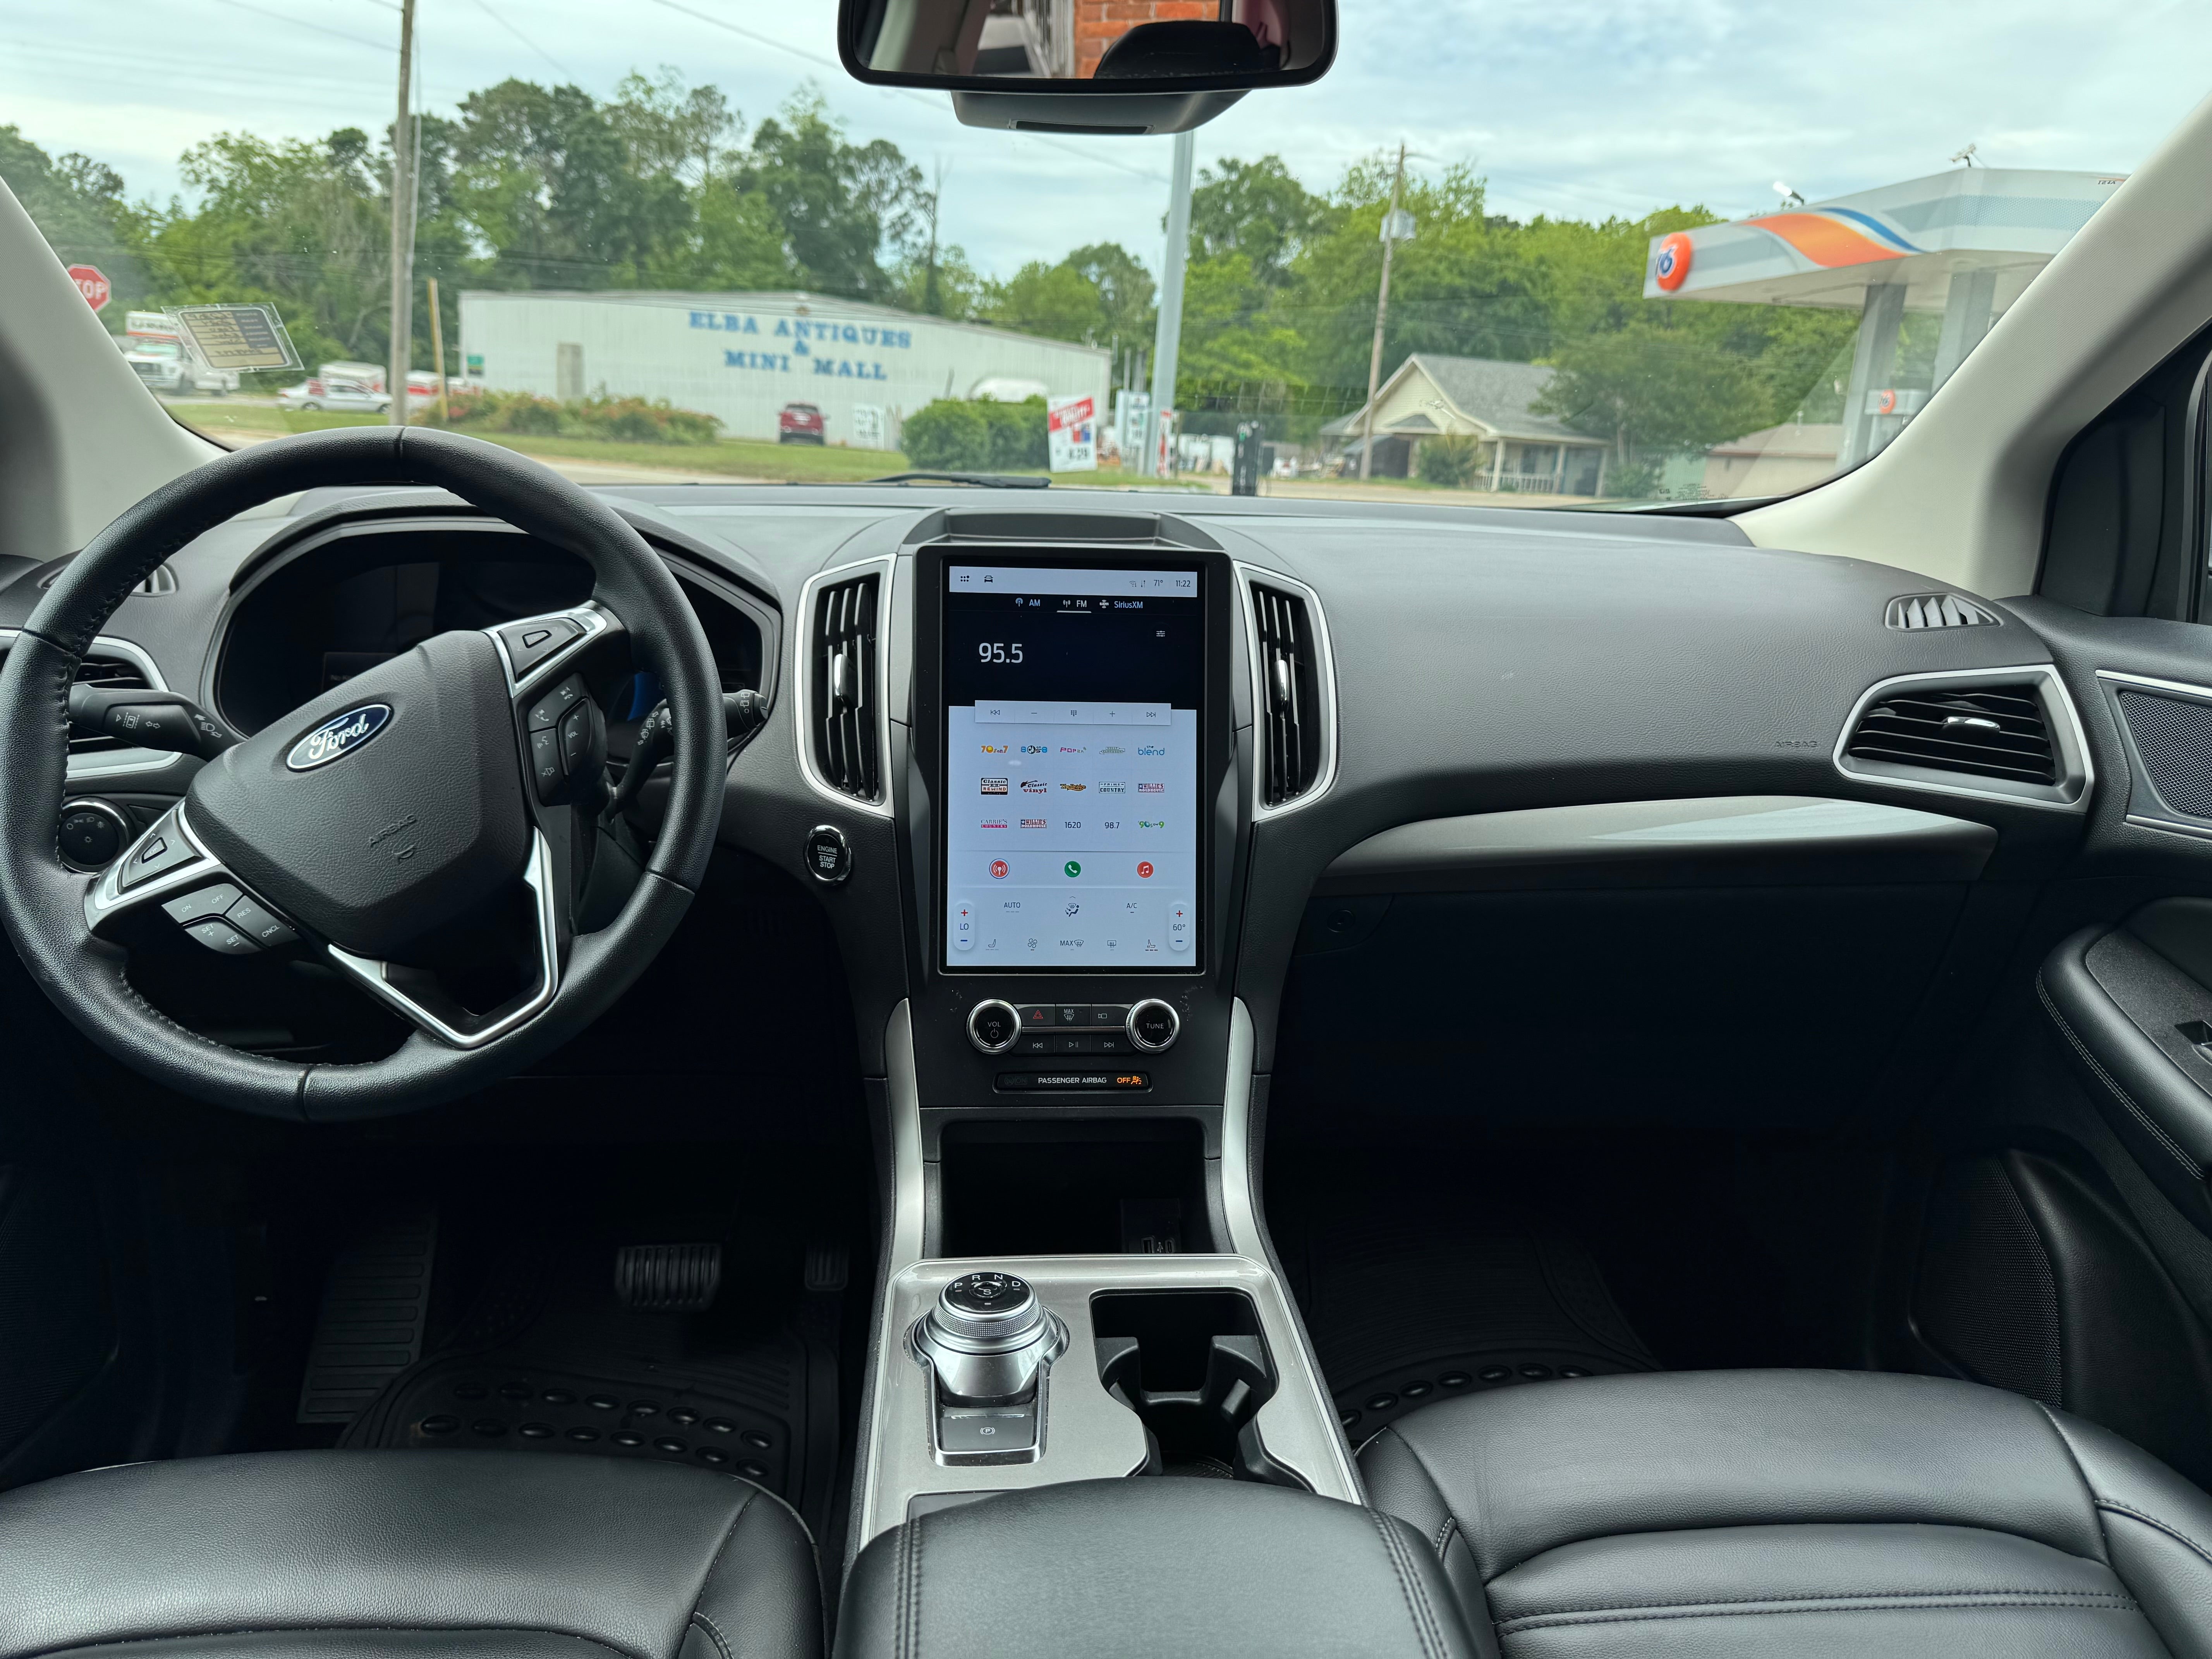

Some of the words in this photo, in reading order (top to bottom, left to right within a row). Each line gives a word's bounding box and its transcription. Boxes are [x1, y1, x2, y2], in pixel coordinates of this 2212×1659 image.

[75, 278, 107, 300] TOP
[689, 311, 758, 335] ELBA
[776, 319, 911, 347] ANTIQUES
[724, 350, 791, 372] MINI
[813, 359, 887, 380] MALL
[979, 643, 1023, 663] 95.5
[309, 714, 369, 759] Ford
[817, 845, 837, 854] ENGINE
[819, 855, 836, 863] START
[211, 894, 224, 904] OFF
[181, 904, 192, 912] ON
[237, 907, 251, 919] RES
[201, 924, 214, 933] SET
[262, 925, 280, 937] CNCL
[226, 934, 239, 945] SET
